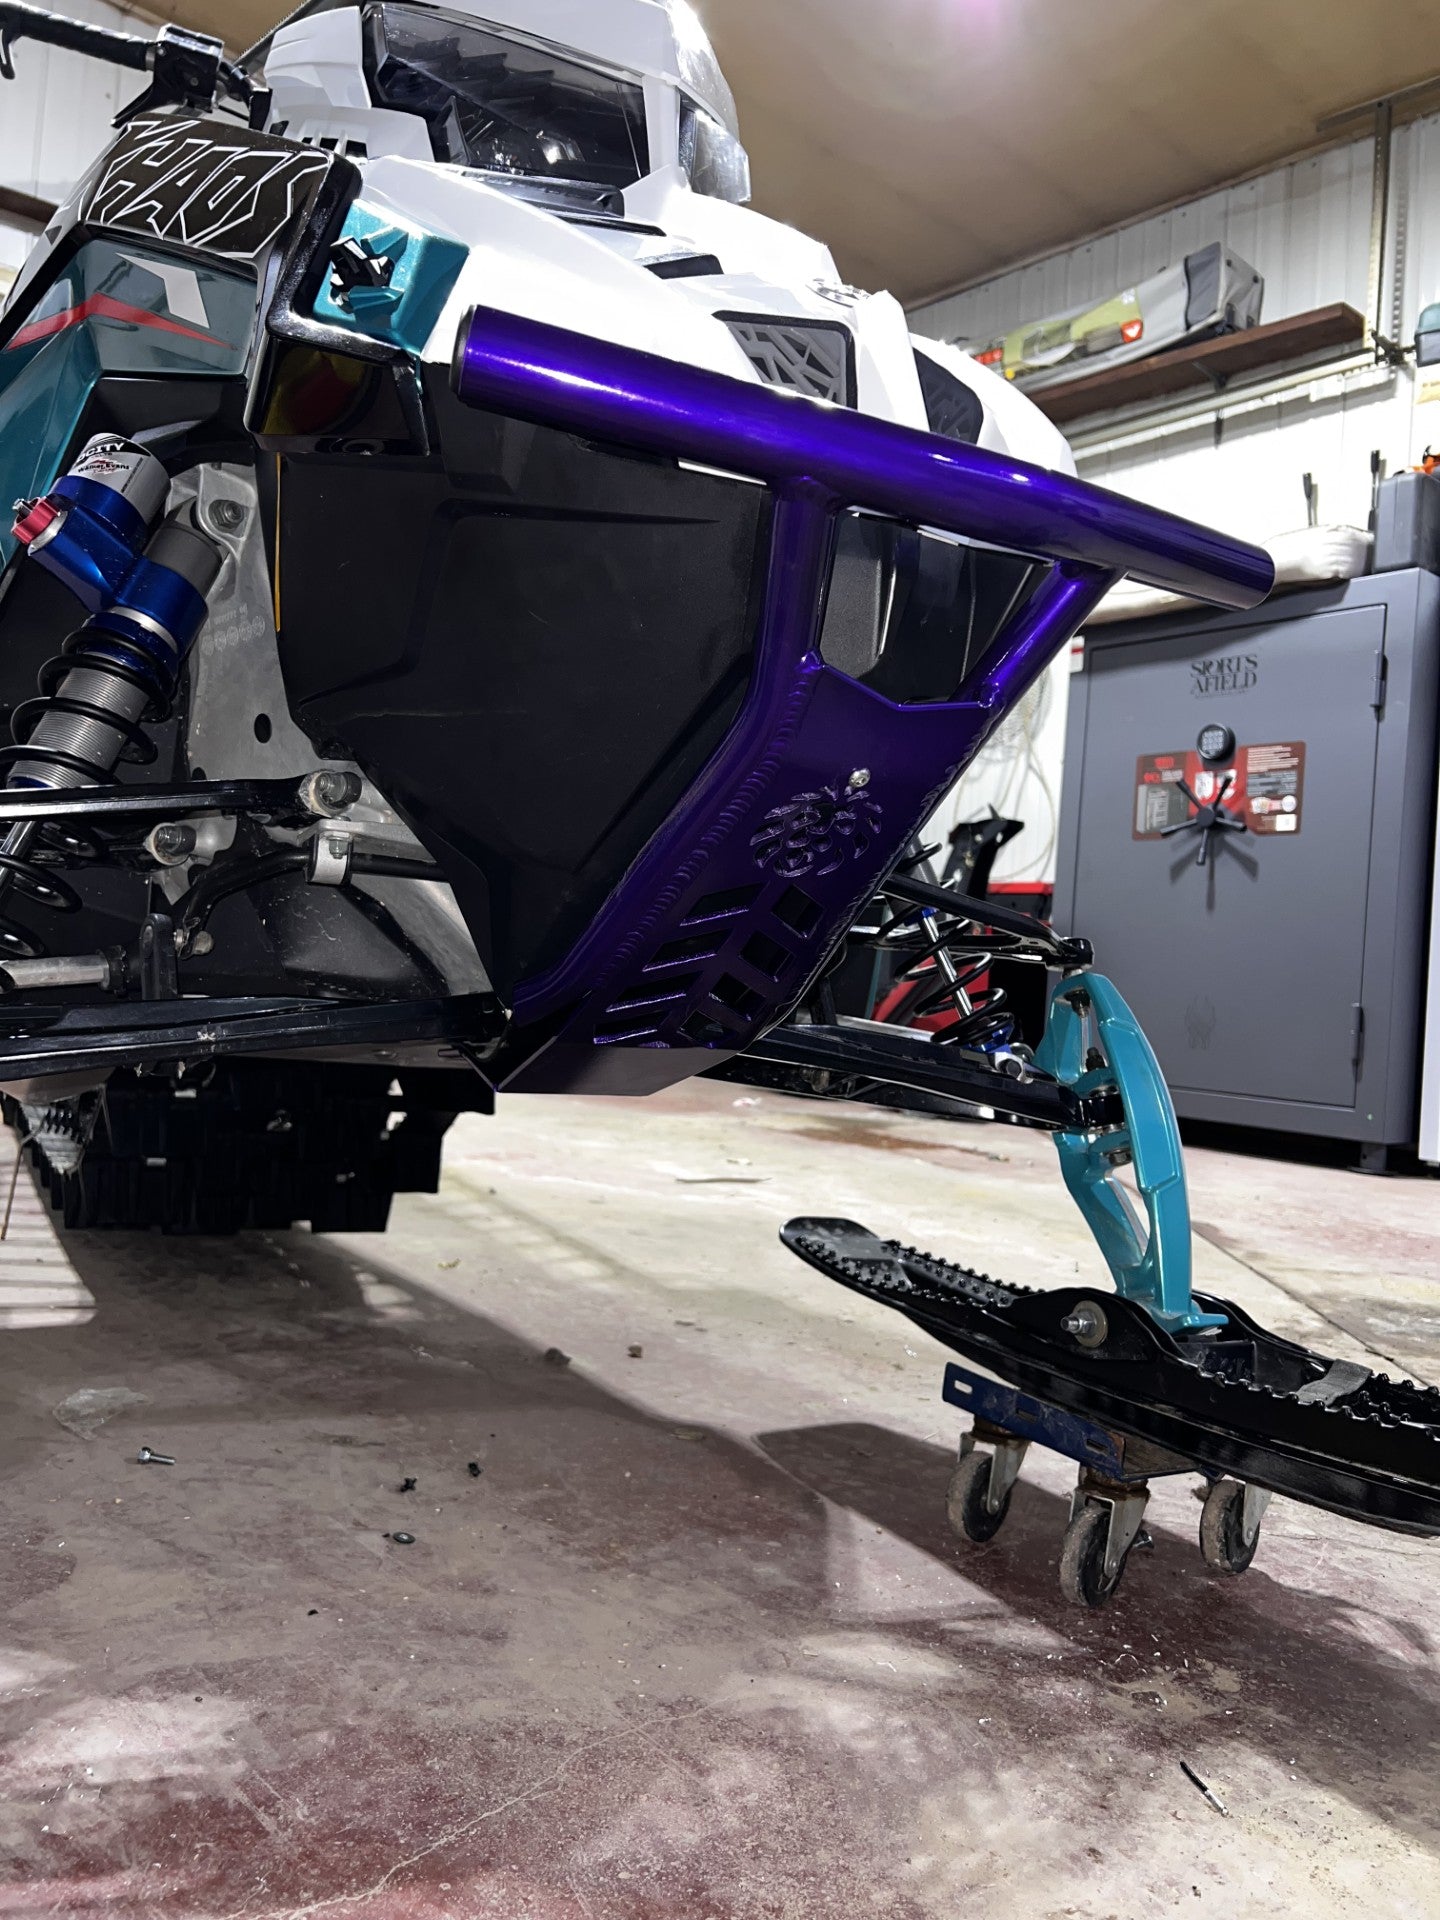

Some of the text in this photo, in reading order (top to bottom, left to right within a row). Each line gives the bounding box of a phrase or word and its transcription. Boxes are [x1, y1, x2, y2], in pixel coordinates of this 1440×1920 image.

[77, 443, 125, 463] OCITY
[1190, 654, 1258, 676] SPORTS
[1190, 671, 1258, 693] AFIELD
